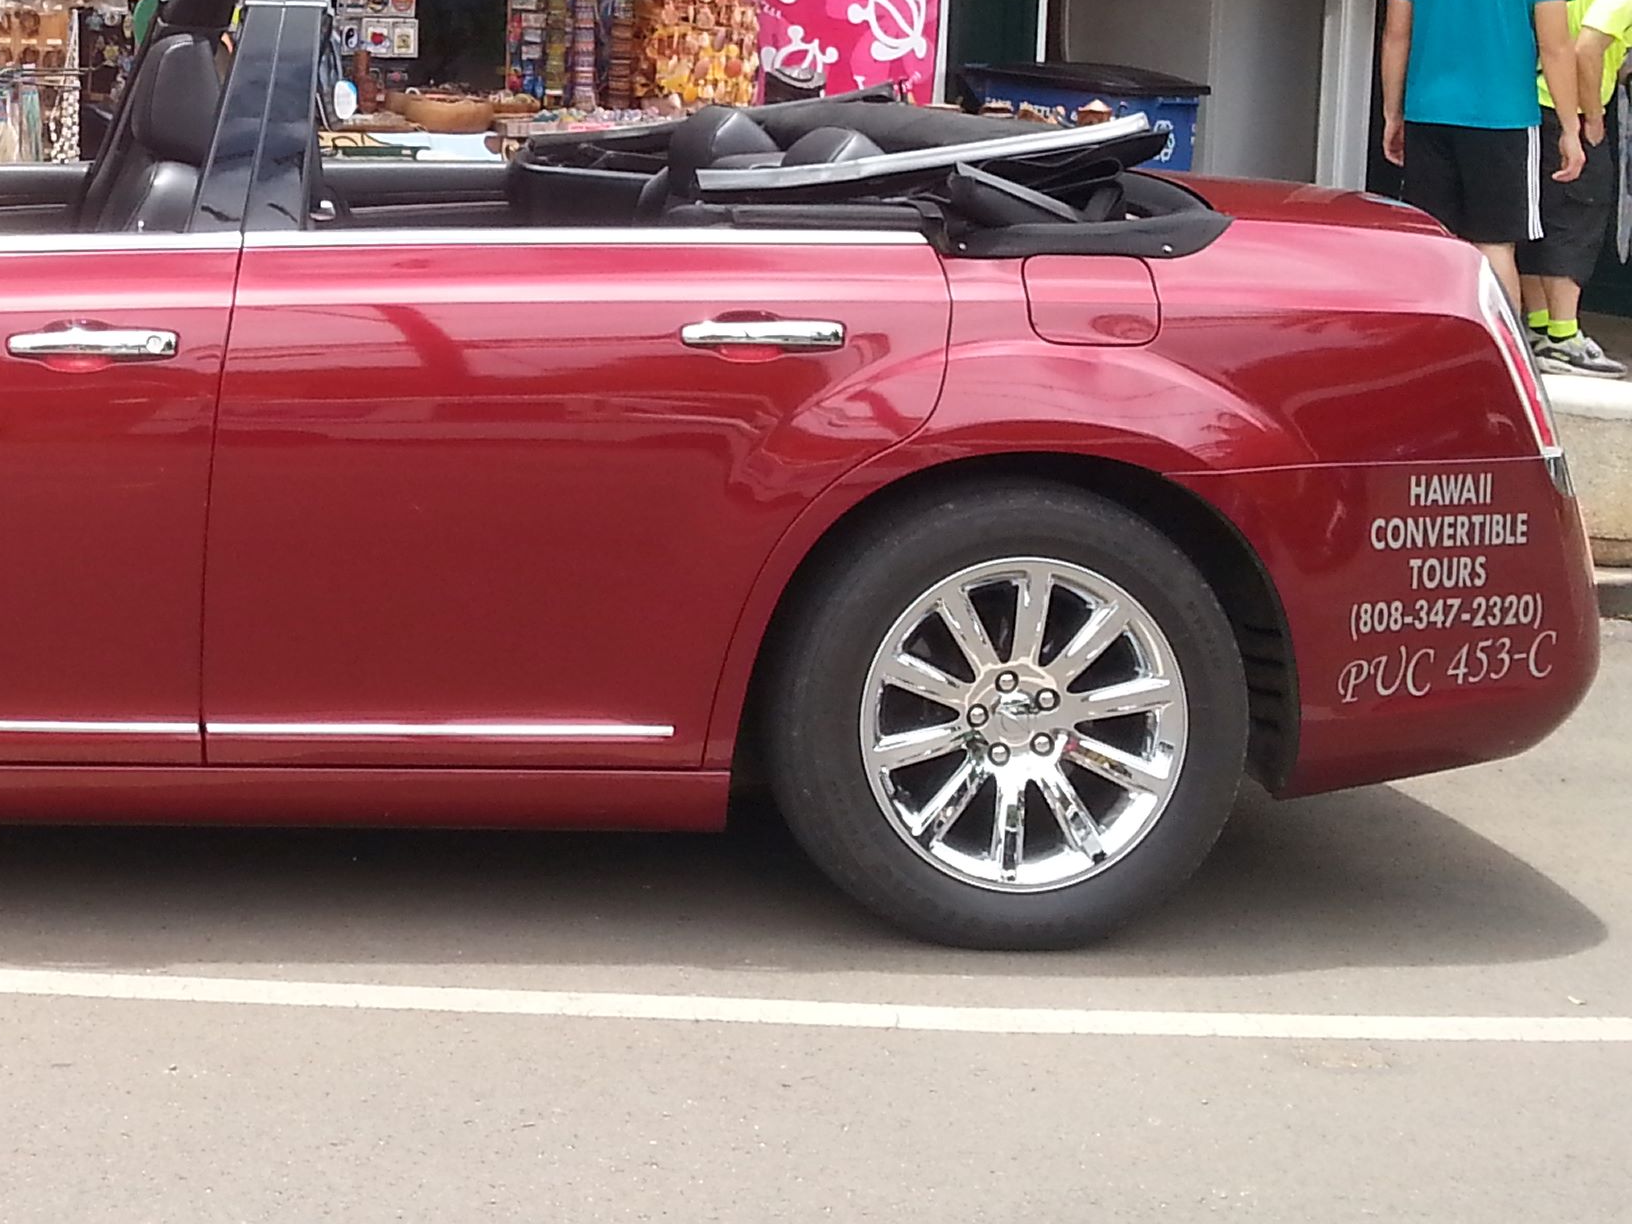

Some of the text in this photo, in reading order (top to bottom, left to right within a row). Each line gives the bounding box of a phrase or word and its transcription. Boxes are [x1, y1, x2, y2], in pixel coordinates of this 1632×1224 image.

[1410, 473, 1492, 506] HAWAII
[1370, 513, 1528, 549] CONVERTIBLE
[1409, 555, 1487, 590] TOURS
[1350, 592, 1543, 642] (808-347-2320)
[1338, 630, 1557, 703] PUC 453-C
